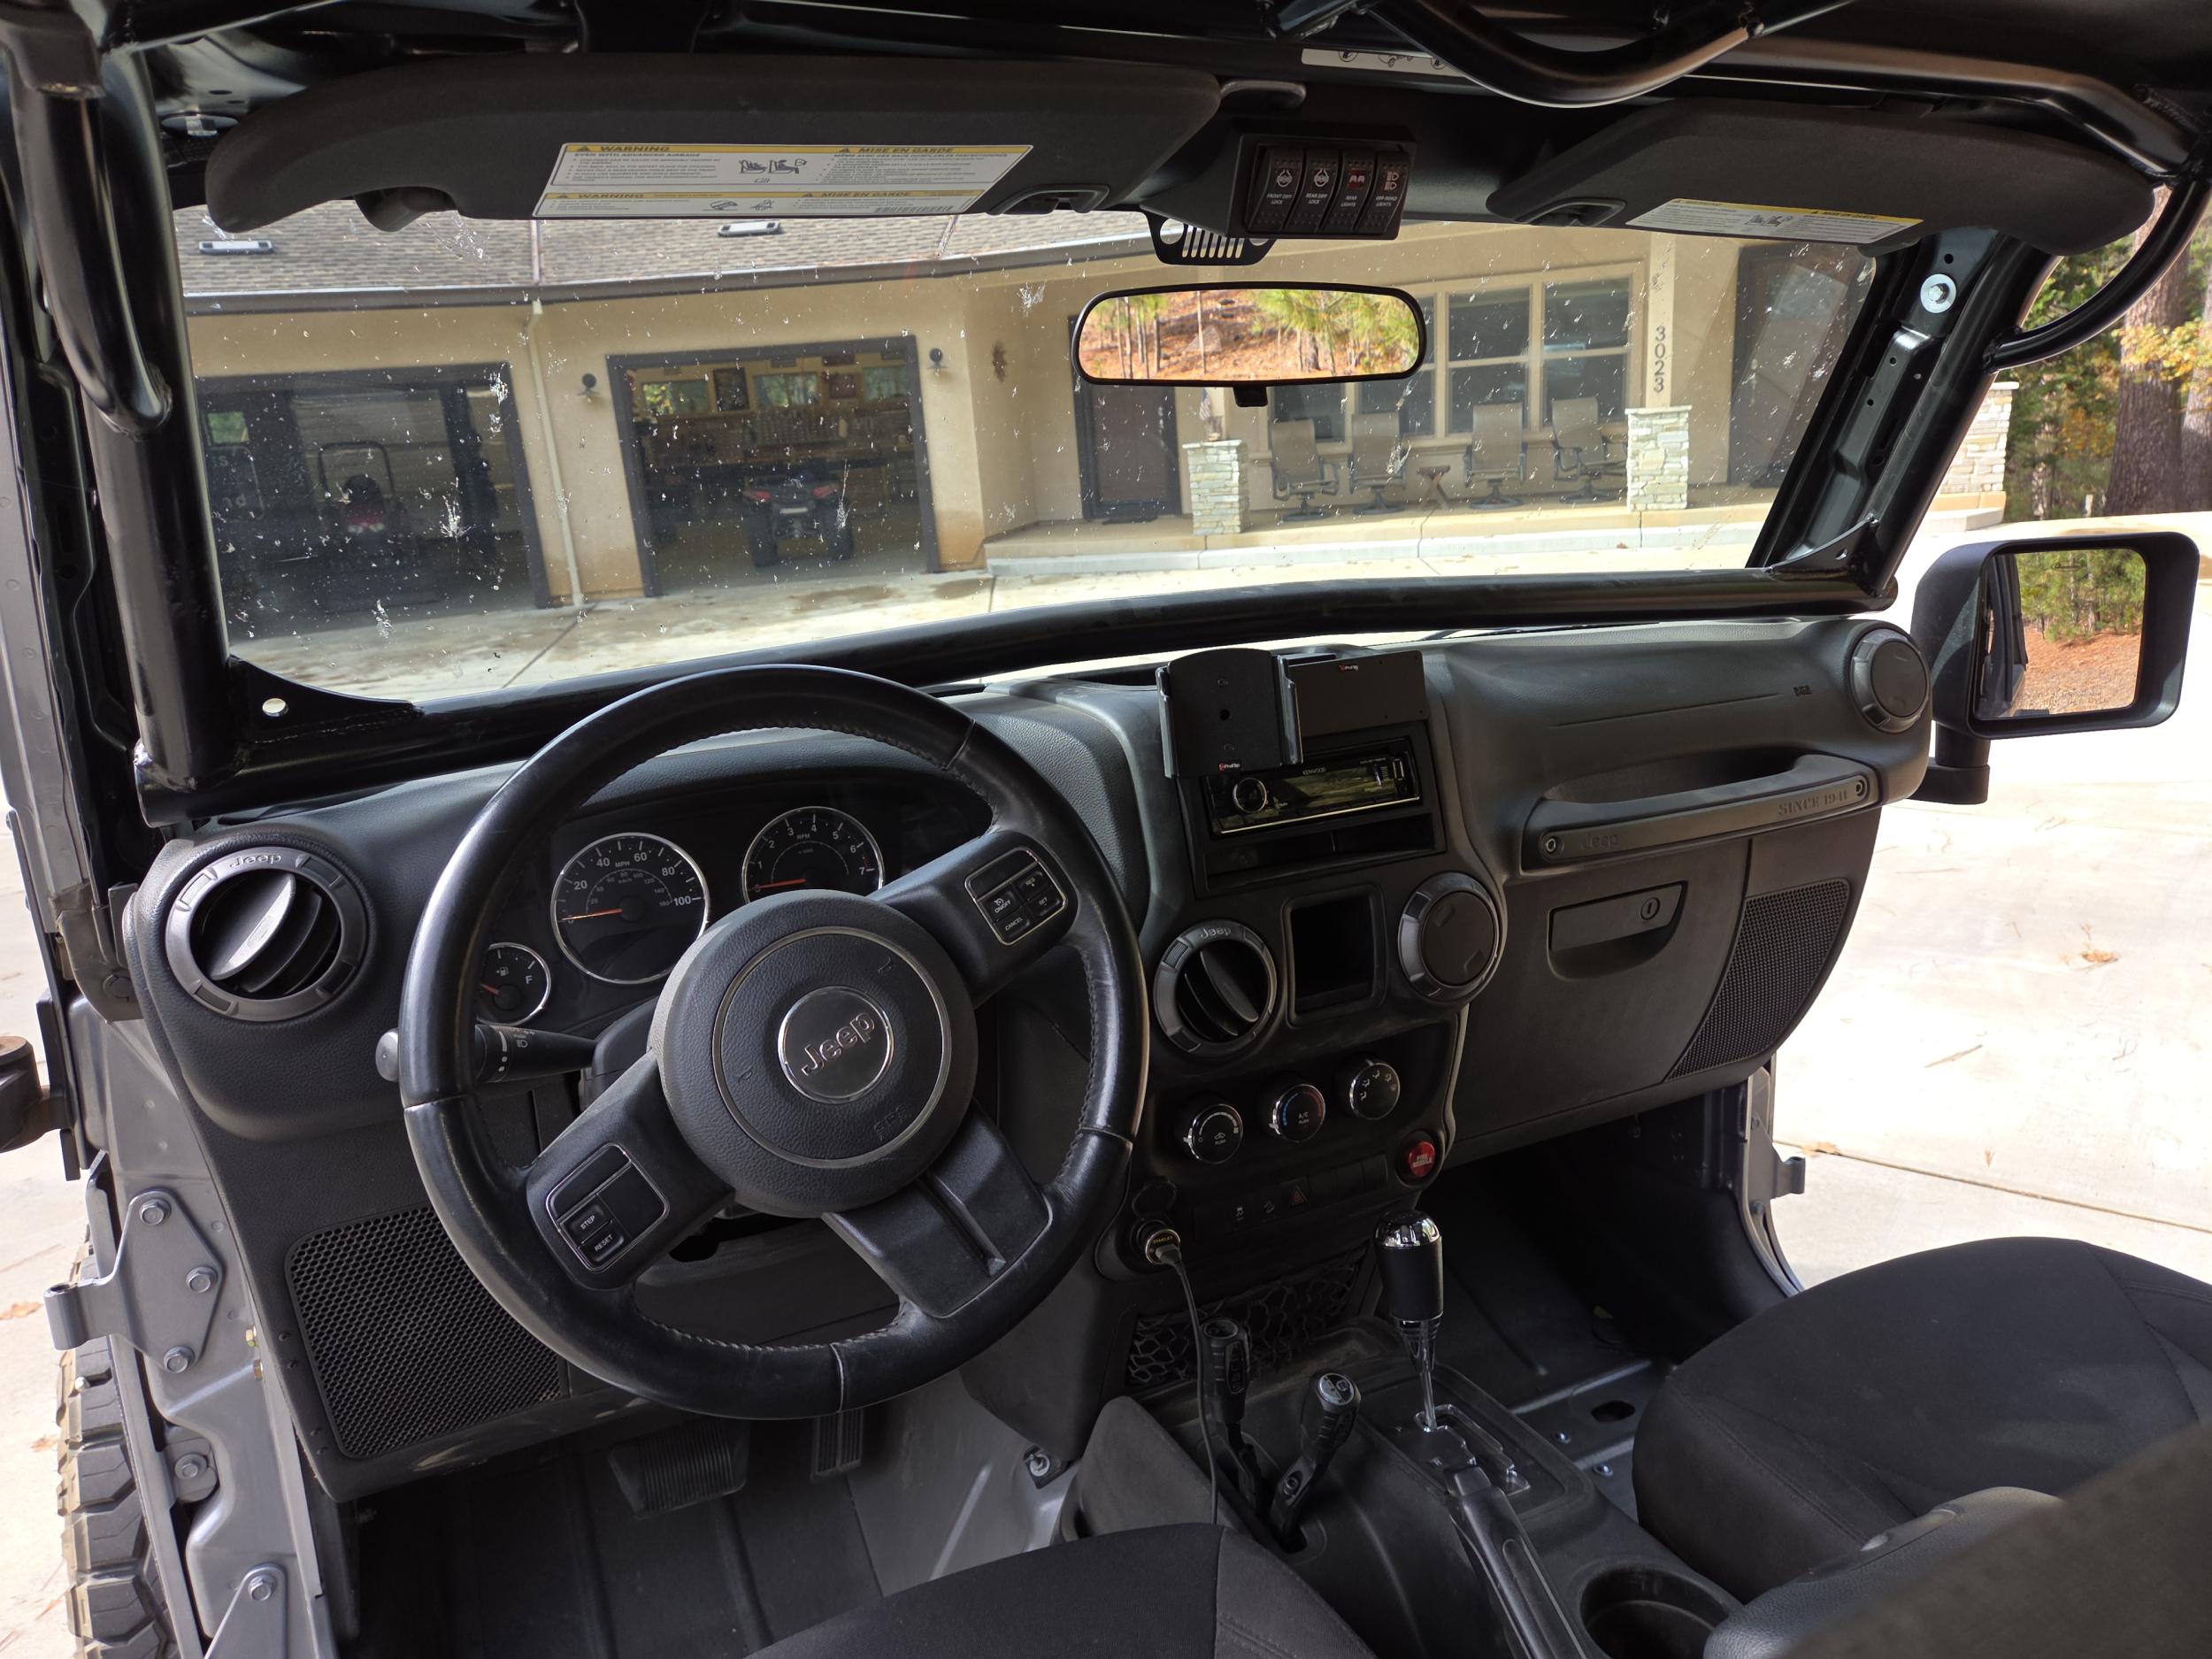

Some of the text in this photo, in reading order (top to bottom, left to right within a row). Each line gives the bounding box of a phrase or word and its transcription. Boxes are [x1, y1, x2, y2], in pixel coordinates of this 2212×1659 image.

[1653, 325, 1666, 394] 3023
[1302, 766, 1327, 776] KENWOOD
[1778, 795, 1820, 816] SINCE
[787, 827, 795, 836] 3
[811, 824, 818, 833] 4
[832, 831, 840, 840] 5
[768, 840, 775, 849] 2
[1582, 832, 1619, 850] Jeep
[849, 844, 856, 854] 6
[229, 853, 282, 868] Jeep
[596, 857, 611, 867] 40
[634, 852, 648, 862] 60
[757, 860, 763, 870] 1
[661, 866, 675, 876] 80
[573, 880, 588, 890] 20
[673, 895, 692, 906] 100
[1200, 926, 1232, 939] Jeep
[526, 975, 534, 984] F
[801, 1012, 875, 1077] Jeep
[580, 1214, 595, 1230] STEP
[594, 1233, 615, 1252] RESET
